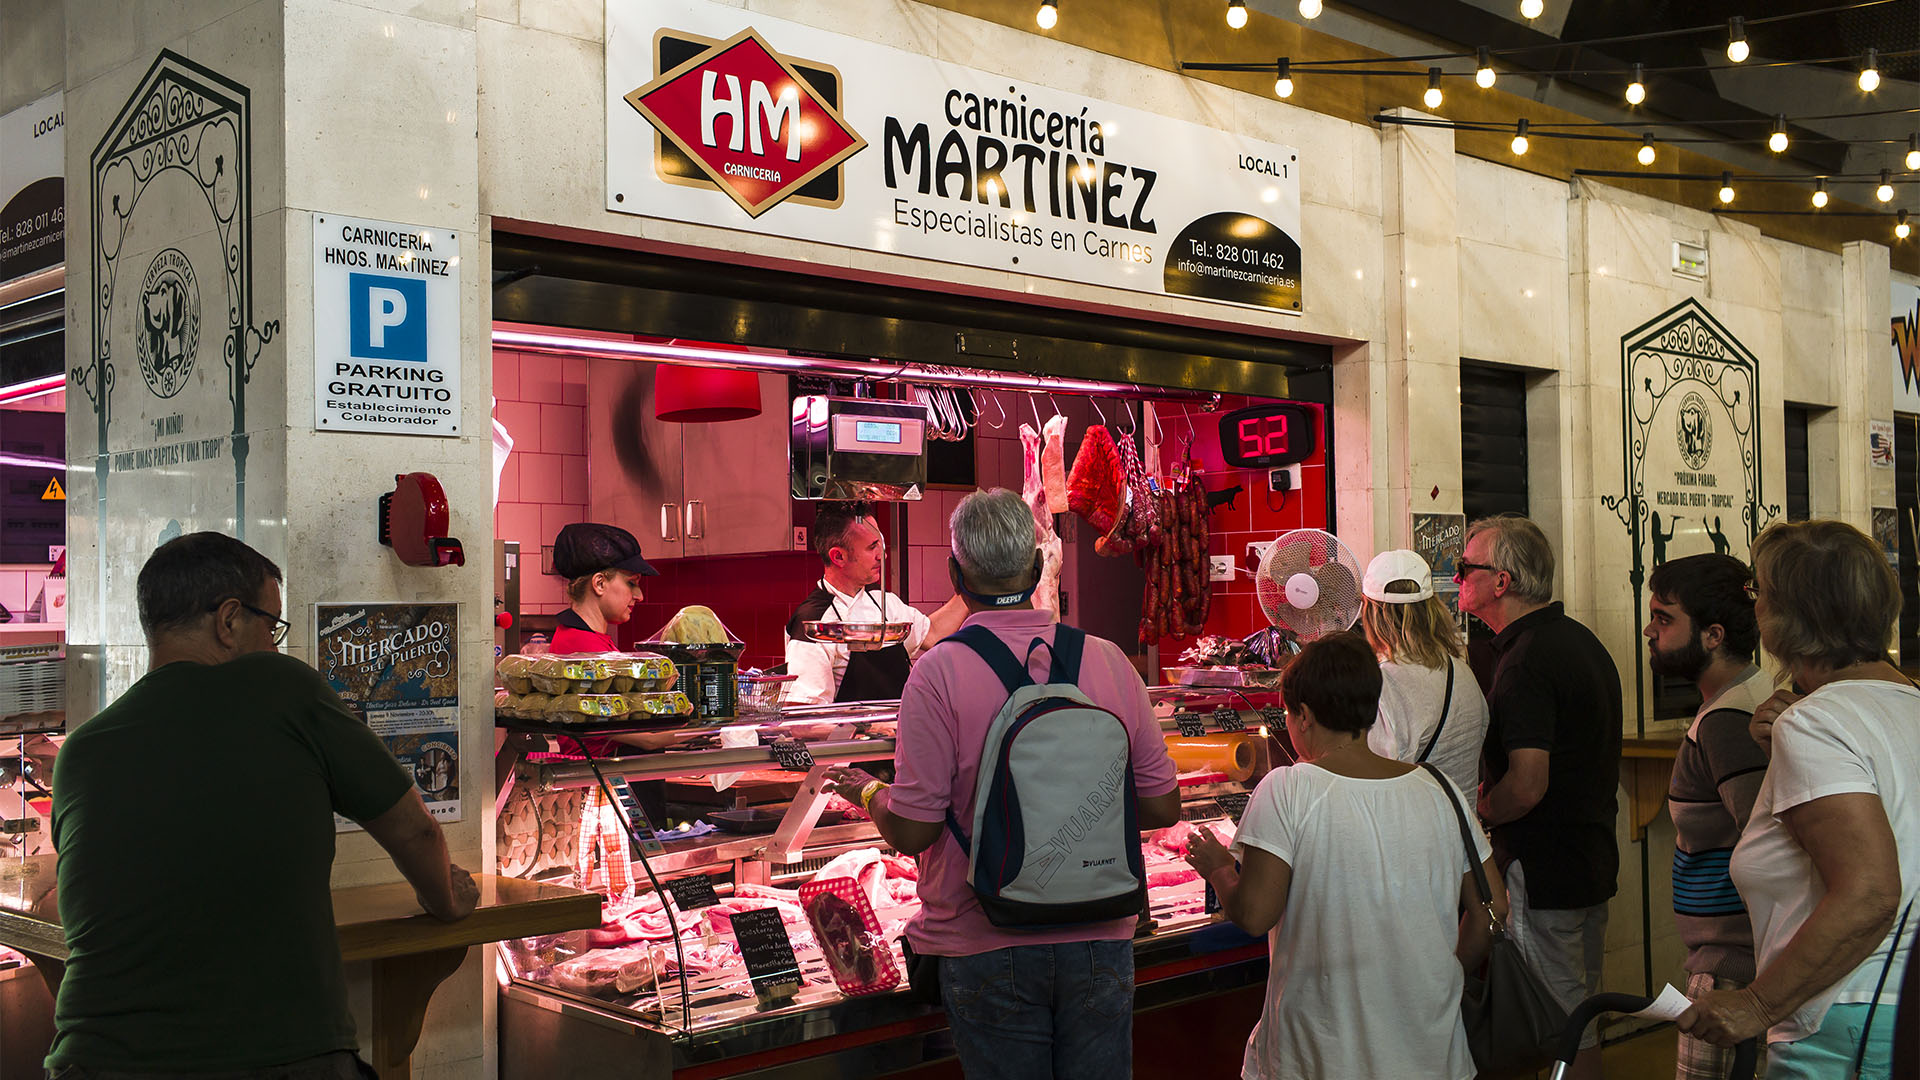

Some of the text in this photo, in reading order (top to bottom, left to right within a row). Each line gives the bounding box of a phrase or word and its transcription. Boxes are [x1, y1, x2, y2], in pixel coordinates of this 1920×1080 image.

[700, 70, 802, 163] HM
[945, 89, 1104, 156] carnicería
[723, 162, 782, 182] CARNICERIA
[884, 116, 1158, 234] MARTINEZ
[1239, 154, 1288, 179] LOCAL 1
[15, 218, 33, 238] 828
[35, 212, 49, 231] 011
[51, 206, 65, 224] 46
[894, 198, 1152, 264] Especialistas en Carnes
[342, 225, 432, 252] CARNICERIA
[325, 247, 449, 276] HNOS. MARTINEZ
[1189, 239, 1284, 270] Tel.: 828 011 462
[145, 254, 193, 289] CERVEZA TROPICAL
[1178, 259, 1295, 289] info@martinezcarniceria.es
[369, 287, 408, 348] P
[335, 362, 444, 382] PARKING
[328, 381, 451, 402] GRATUITO
[326, 400, 452, 416] Establecimiento
[341, 412, 438, 425] Colaborador
[166, 412, 184, 435] NIÑO!
[1238, 414, 1288, 459] 52
[114, 452, 135, 473] PONME
[136, 449, 153, 469] UNAS
[153, 444, 179, 467] PAPITAS
[180, 444, 185, 463] Y
[186, 441, 200, 462] UNA
[1656, 491, 1679, 506] MERCADO
[1679, 492, 1688, 506] DEL
[1689, 493, 1706, 507] PUERTO
[341, 621, 444, 667] MERCADO
[360, 640, 443, 673] DEL PUERTO
[421, 741, 458, 761] CONCIERTO
[1049, 747, 1129, 855] VUARNET
[1089, 858, 1117, 867] VUARNET
